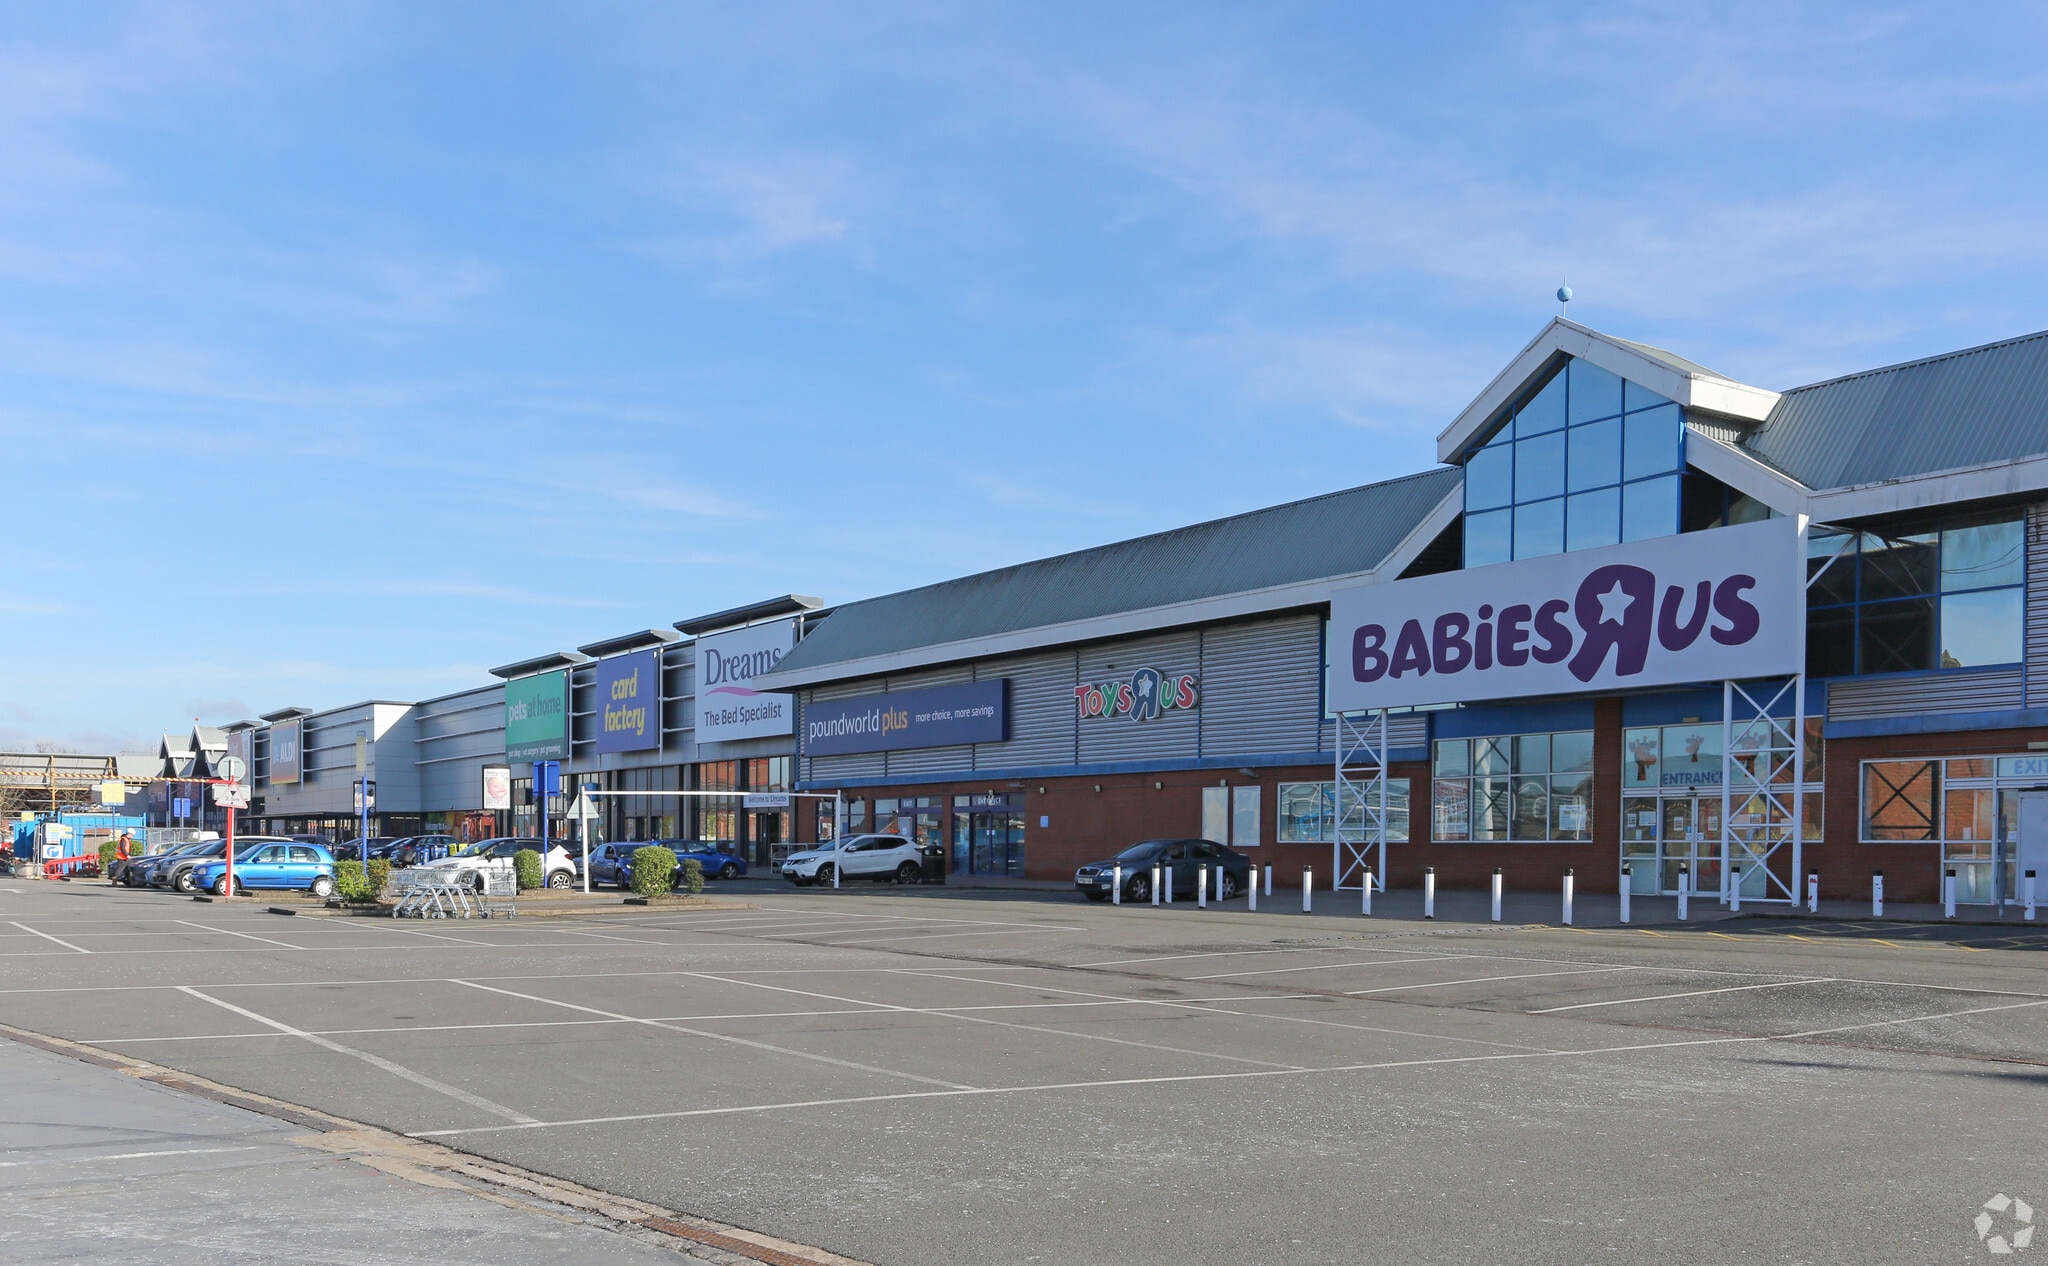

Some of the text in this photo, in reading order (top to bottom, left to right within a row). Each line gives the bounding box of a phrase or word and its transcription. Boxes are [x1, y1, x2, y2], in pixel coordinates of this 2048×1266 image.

[611, 667, 638, 700] card
[508, 693, 561, 727] pets at home
[604, 703, 645, 736] factory
[704, 701, 782, 727] The Bed Specialist
[809, 704, 995, 744] poundworld plus more choice, more savings
[279, 742, 296, 763] ALDI
